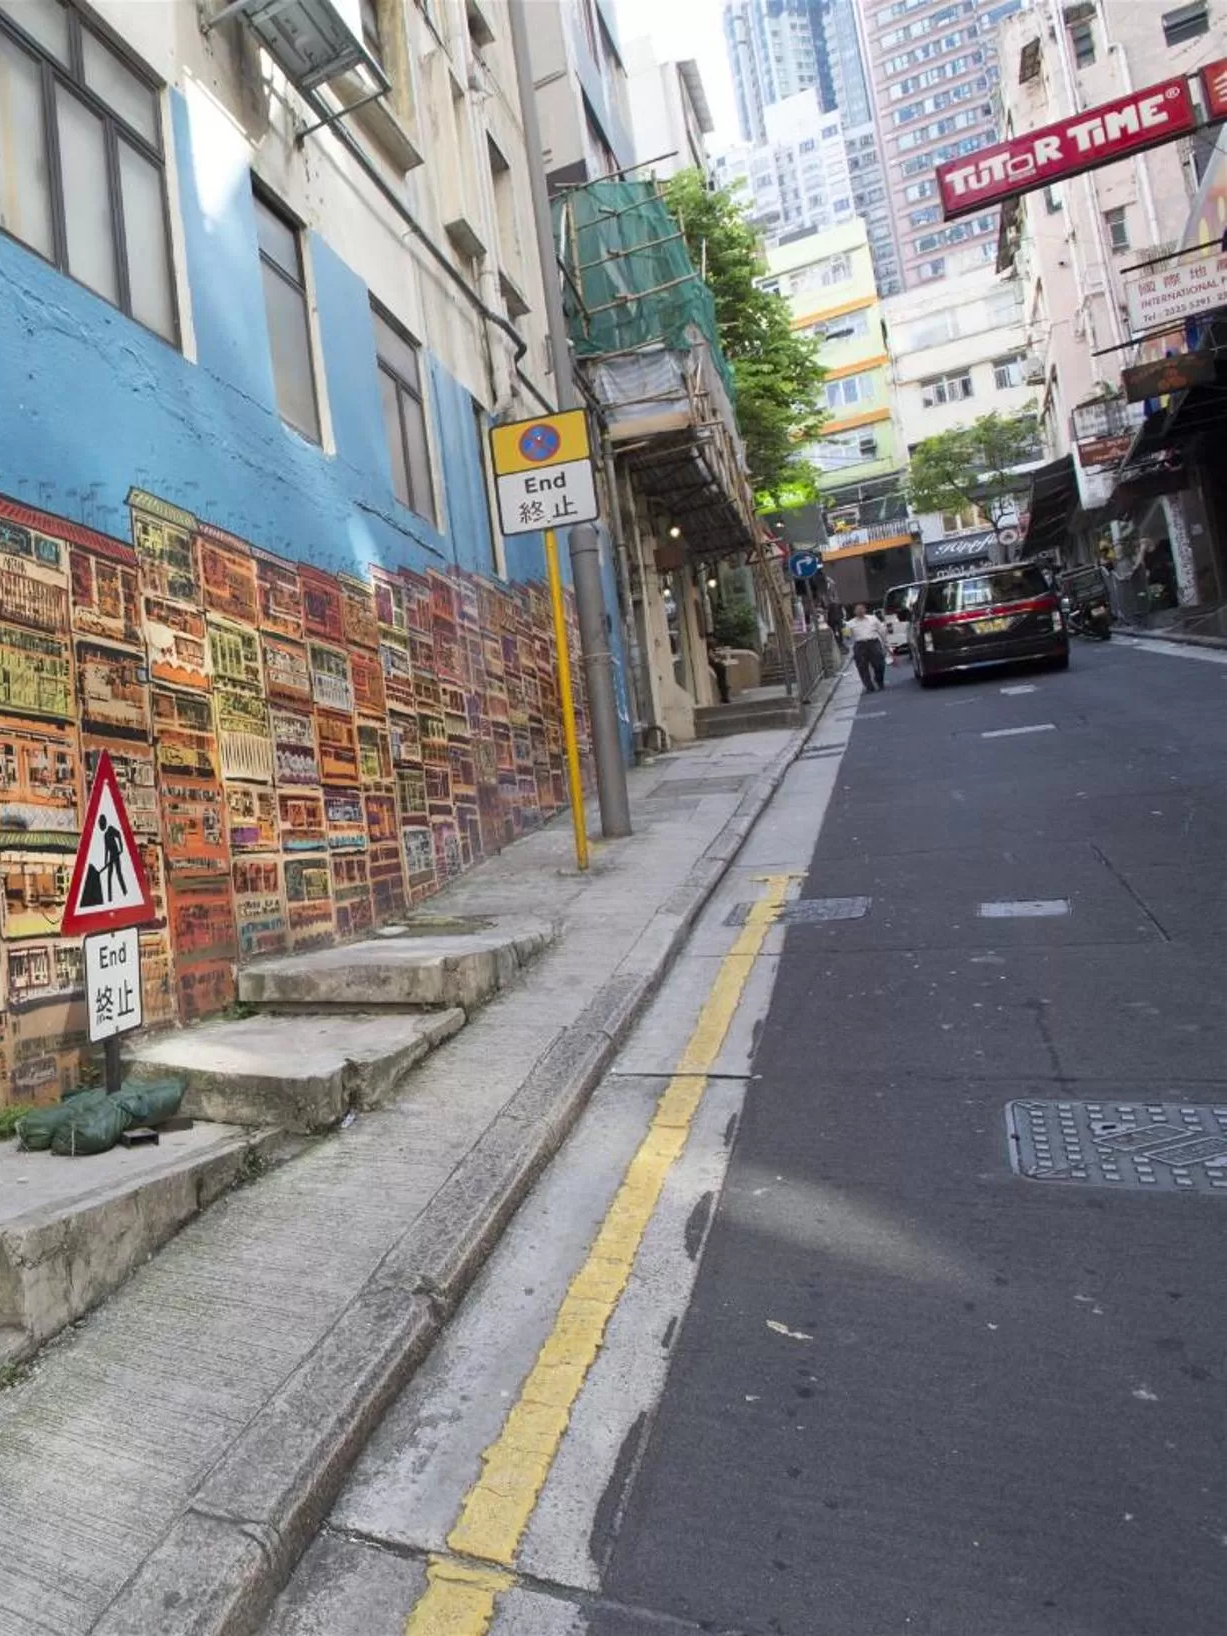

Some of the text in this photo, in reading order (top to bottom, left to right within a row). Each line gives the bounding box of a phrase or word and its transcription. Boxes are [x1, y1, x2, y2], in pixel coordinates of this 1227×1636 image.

[945, 135, 1063, 197] TUTOR
[1141, 280, 1219, 309] INTERNATIONAL
[525, 471, 567, 494] End
[519, 495, 578, 524] 終止
[99, 942, 127, 970] End
[95, 979, 135, 1025] 終止
